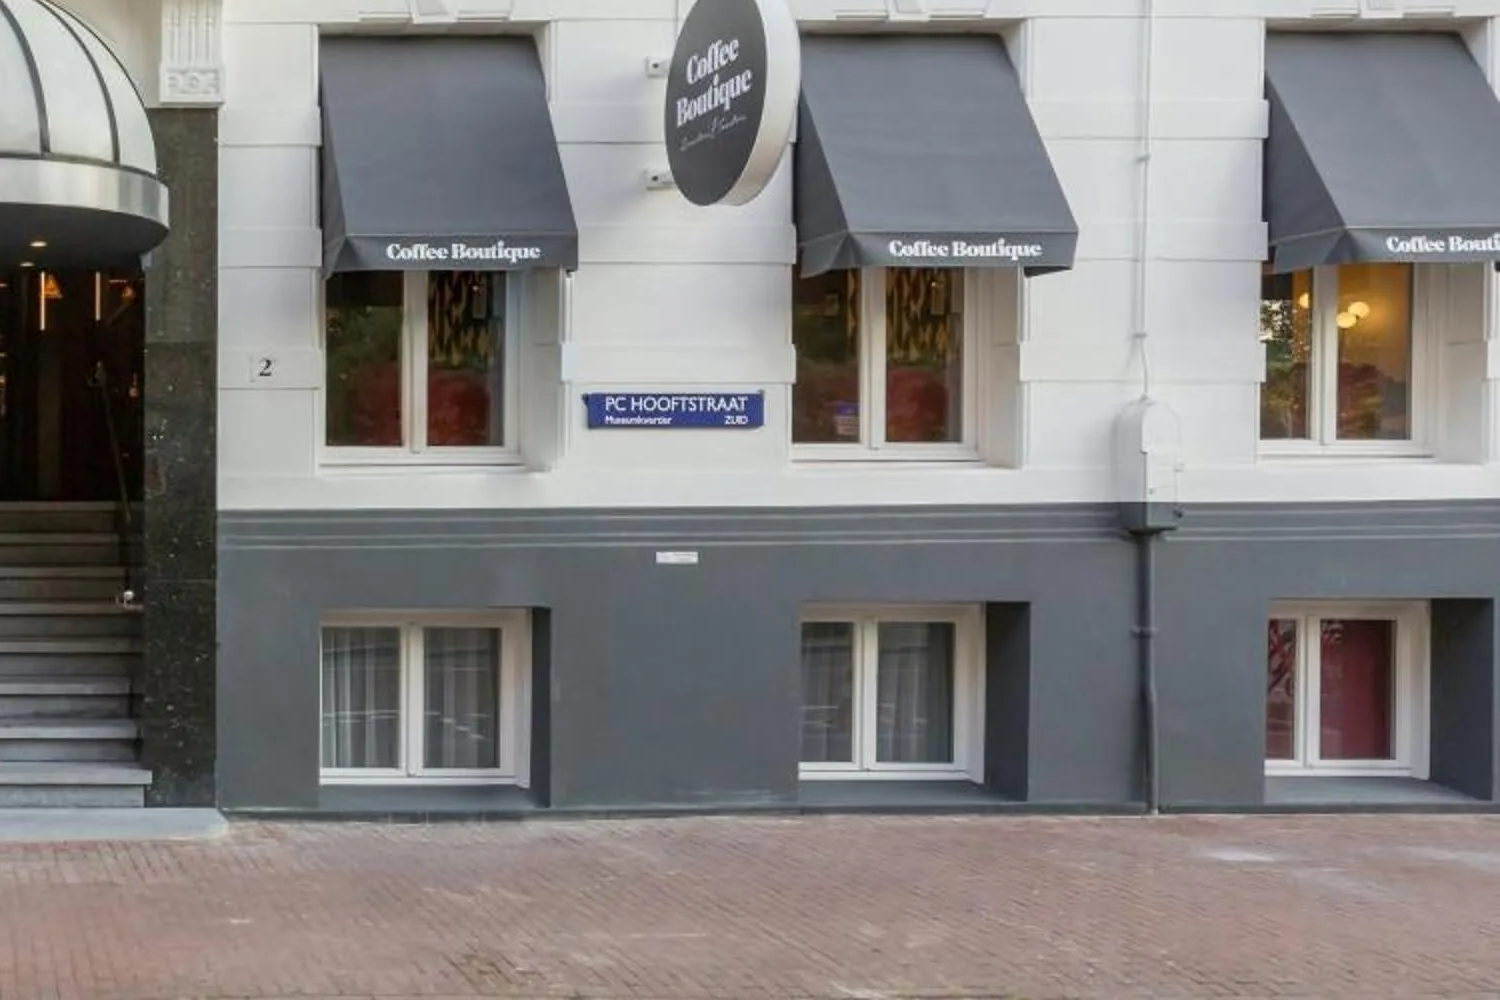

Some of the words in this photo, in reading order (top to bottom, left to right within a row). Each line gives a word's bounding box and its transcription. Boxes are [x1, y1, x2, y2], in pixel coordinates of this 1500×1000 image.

[686, 38, 739, 85] Coffee
[676, 69, 753, 128] Boutique
[386, 243, 449, 260] Coffee
[451, 240, 541, 263] Boutique
[889, 240, 949, 257] Coffee
[953, 238, 1042, 261] Boutique
[1385, 235, 1445, 252] Coffee
[259, 357, 272, 377] 2
[605, 396, 627, 412] PC
[631, 397, 748, 412] HOOFTSTRAAT
[724, 415, 748, 425] ZUID
